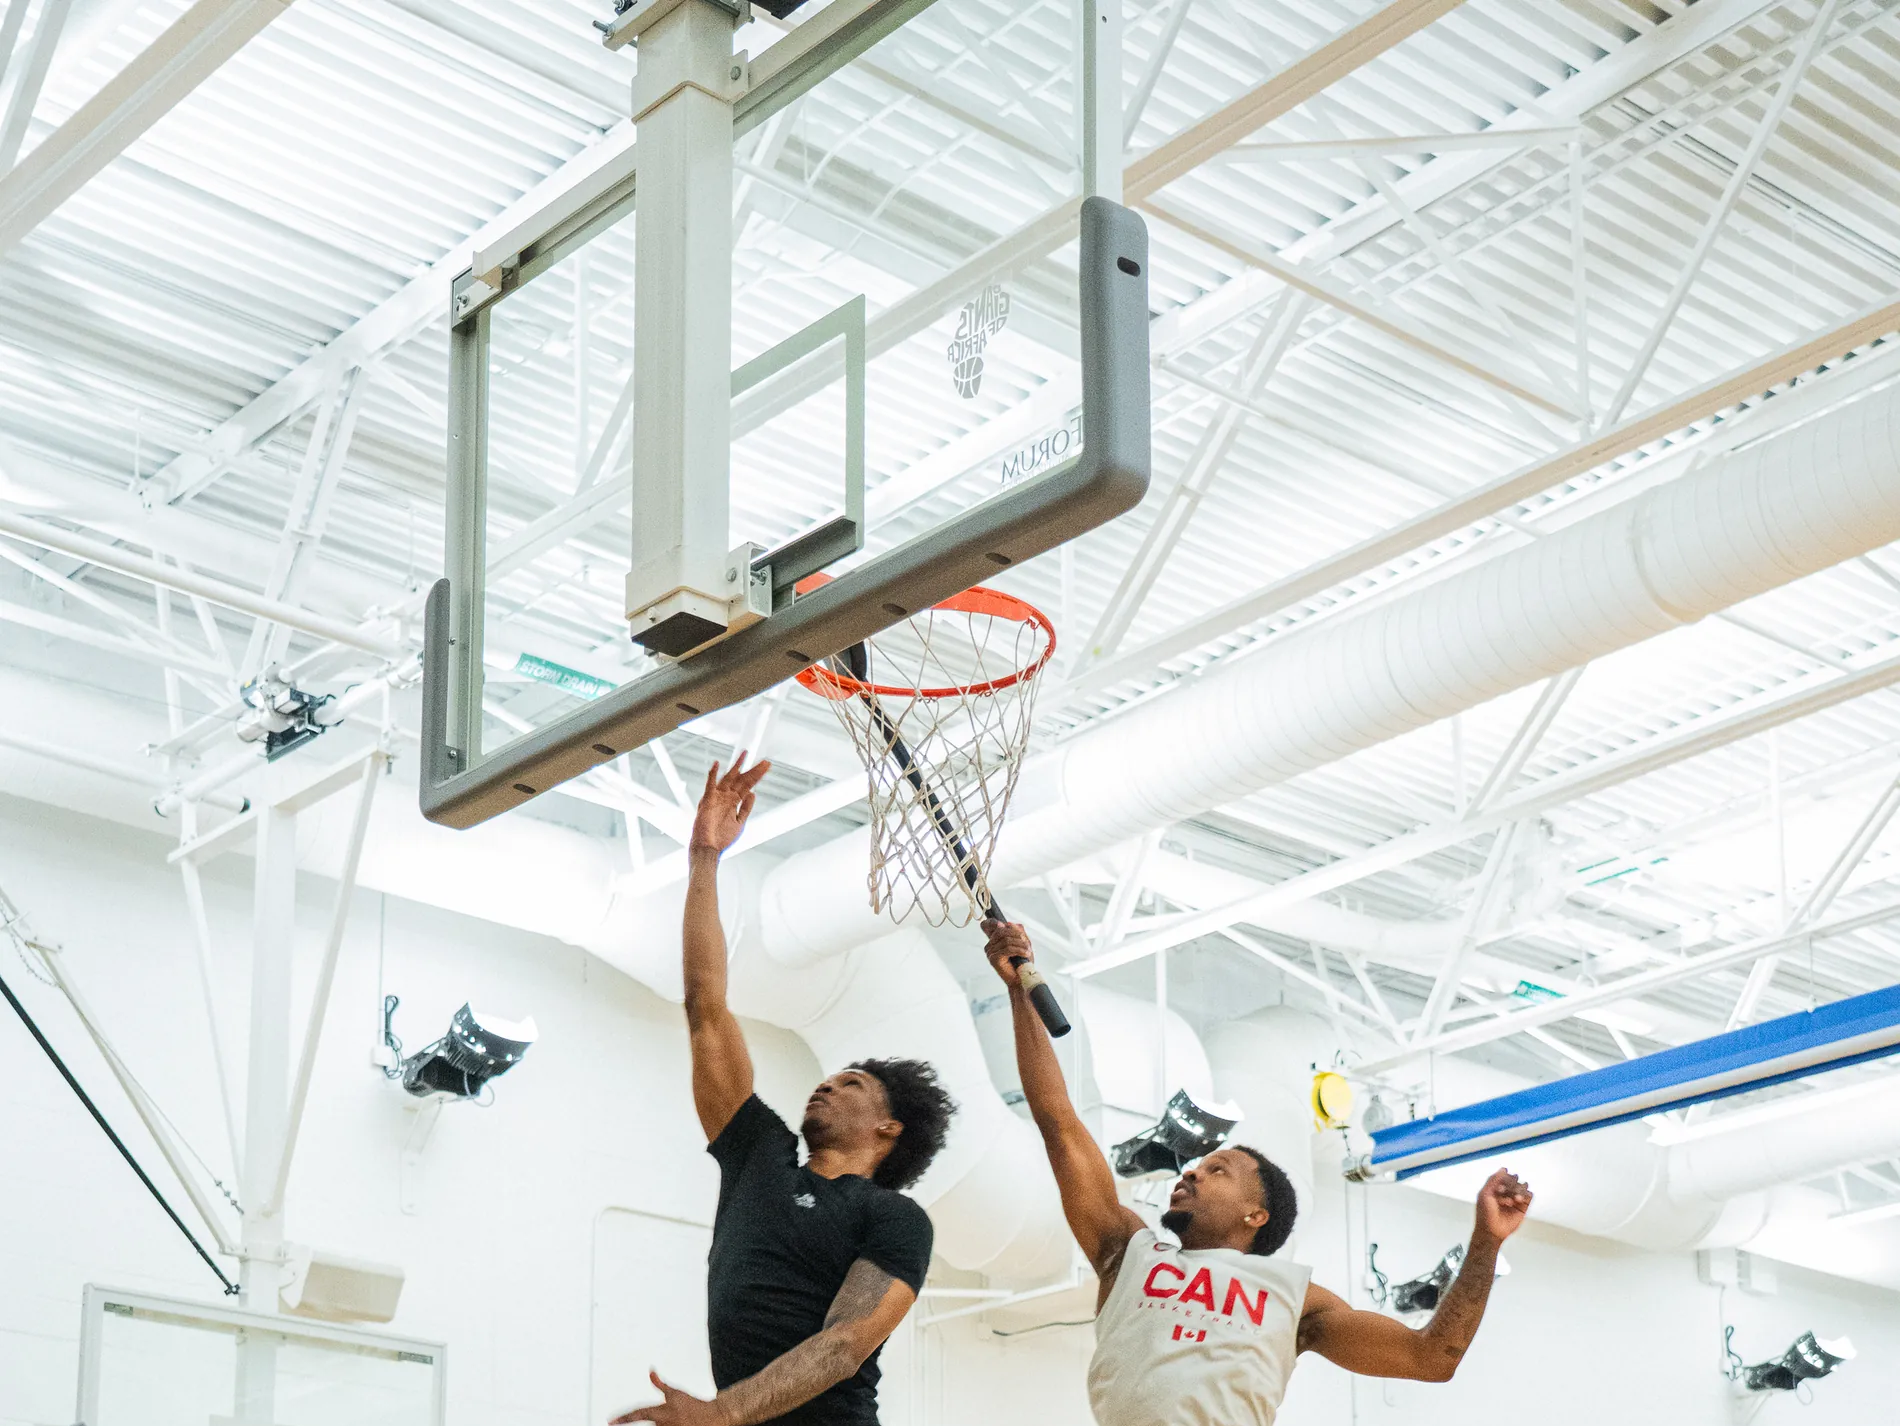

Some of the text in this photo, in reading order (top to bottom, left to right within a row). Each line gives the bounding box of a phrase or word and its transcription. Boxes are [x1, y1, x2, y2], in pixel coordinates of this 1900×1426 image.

[520, 661, 598, 695] STORM DRAIN
[1143, 1261, 1269, 1326] CAN
[1137, 1301, 1262, 1336] BASKETBALL
